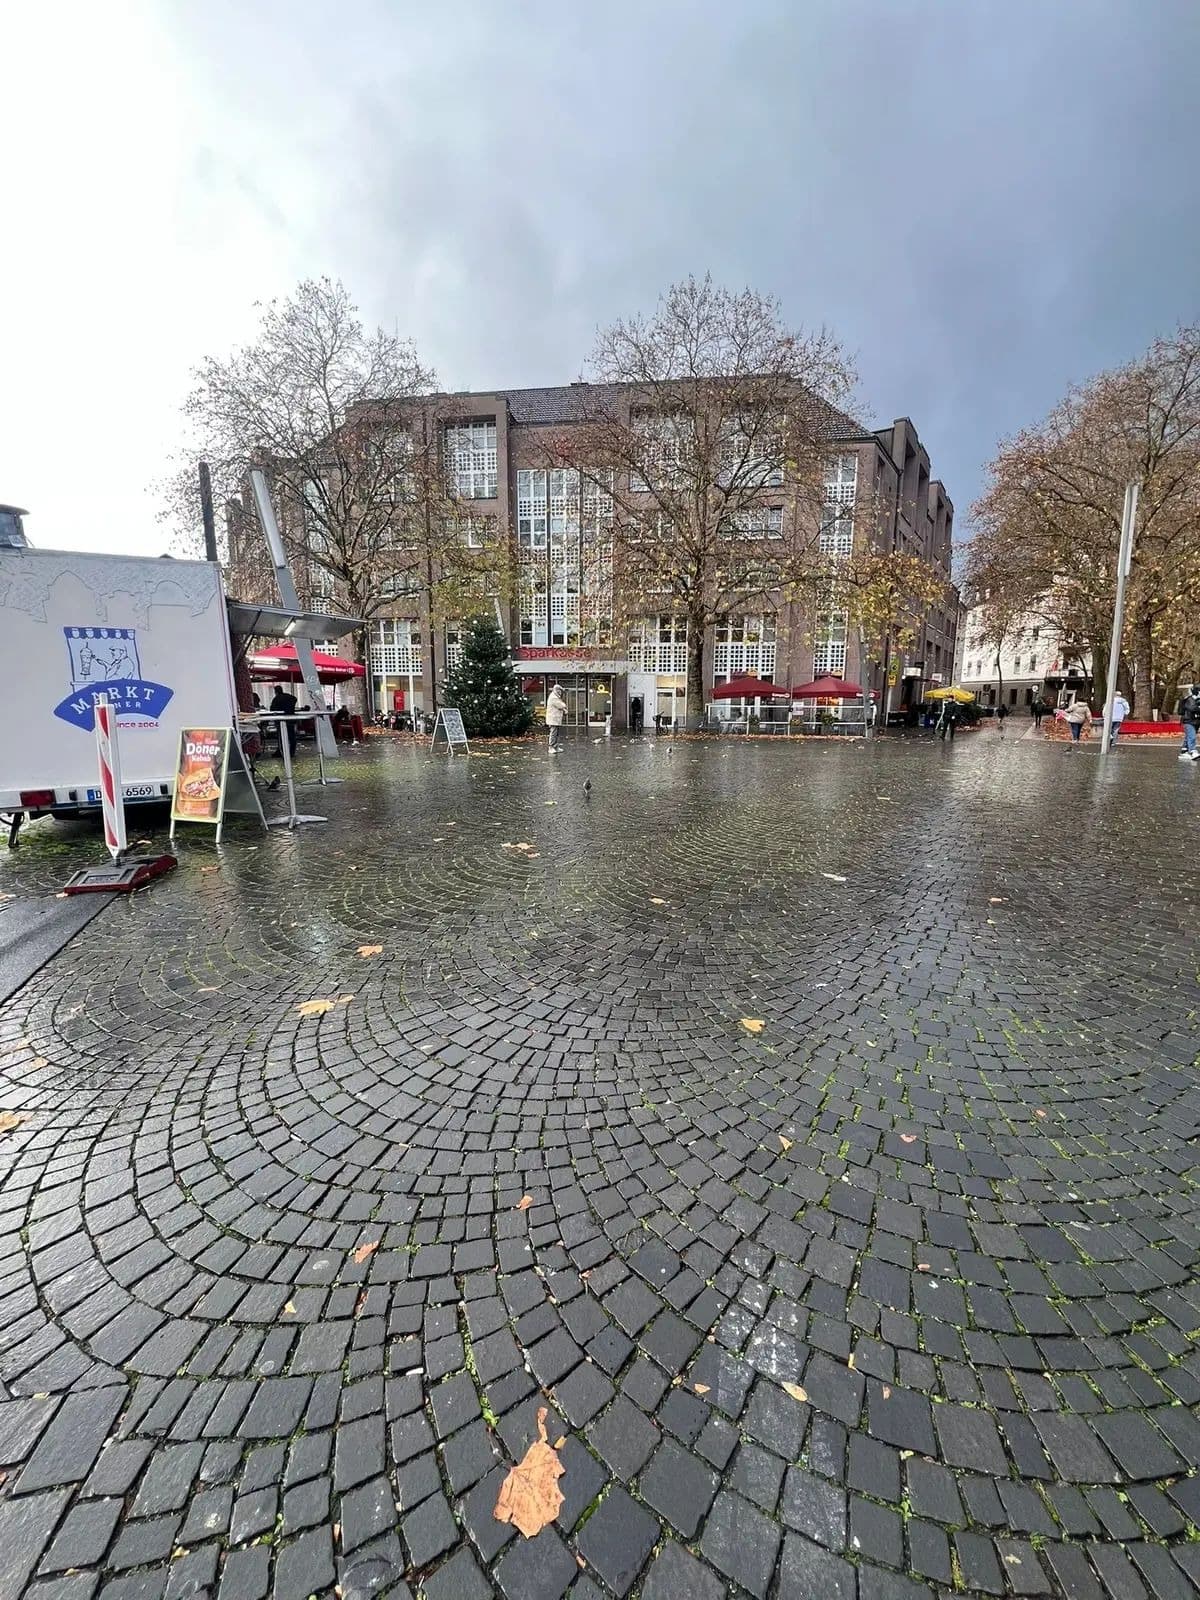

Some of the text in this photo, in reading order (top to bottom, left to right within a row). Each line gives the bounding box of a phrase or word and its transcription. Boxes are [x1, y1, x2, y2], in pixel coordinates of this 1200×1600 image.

[520, 646, 593, 659] Sparkasse
[186, 742, 220, 755] Döner
[126, 786, 152, 797] 6569
